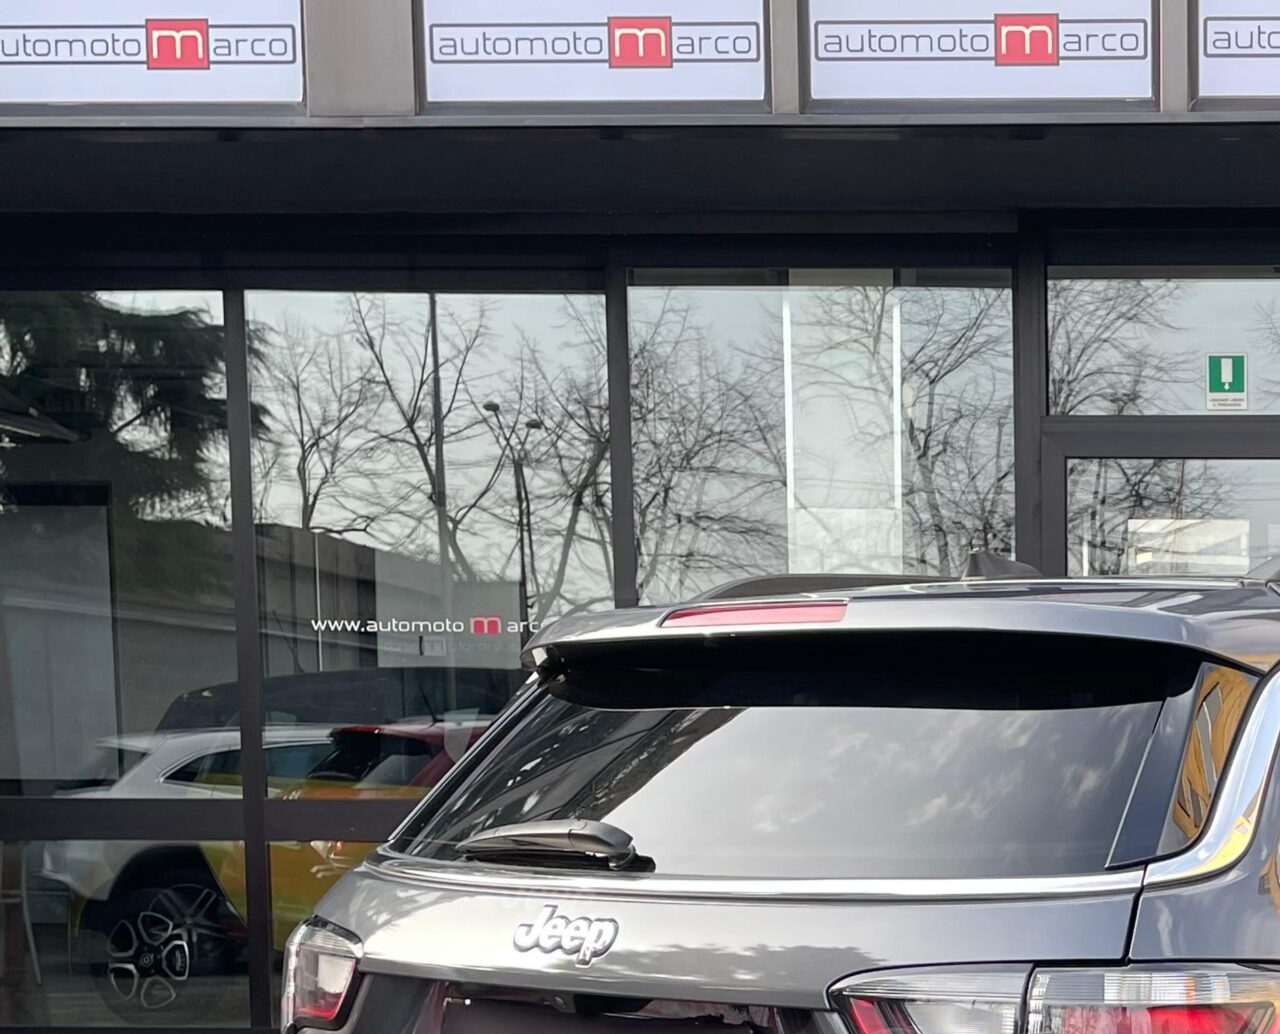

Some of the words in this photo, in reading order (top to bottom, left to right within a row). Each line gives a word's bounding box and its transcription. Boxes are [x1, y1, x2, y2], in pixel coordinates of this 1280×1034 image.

[0, 33, 142, 57] utomoto
[438, 31, 604, 56] automoto
[823, 28, 990, 54] automoto
[513, 904, 620, 967] Jeep
